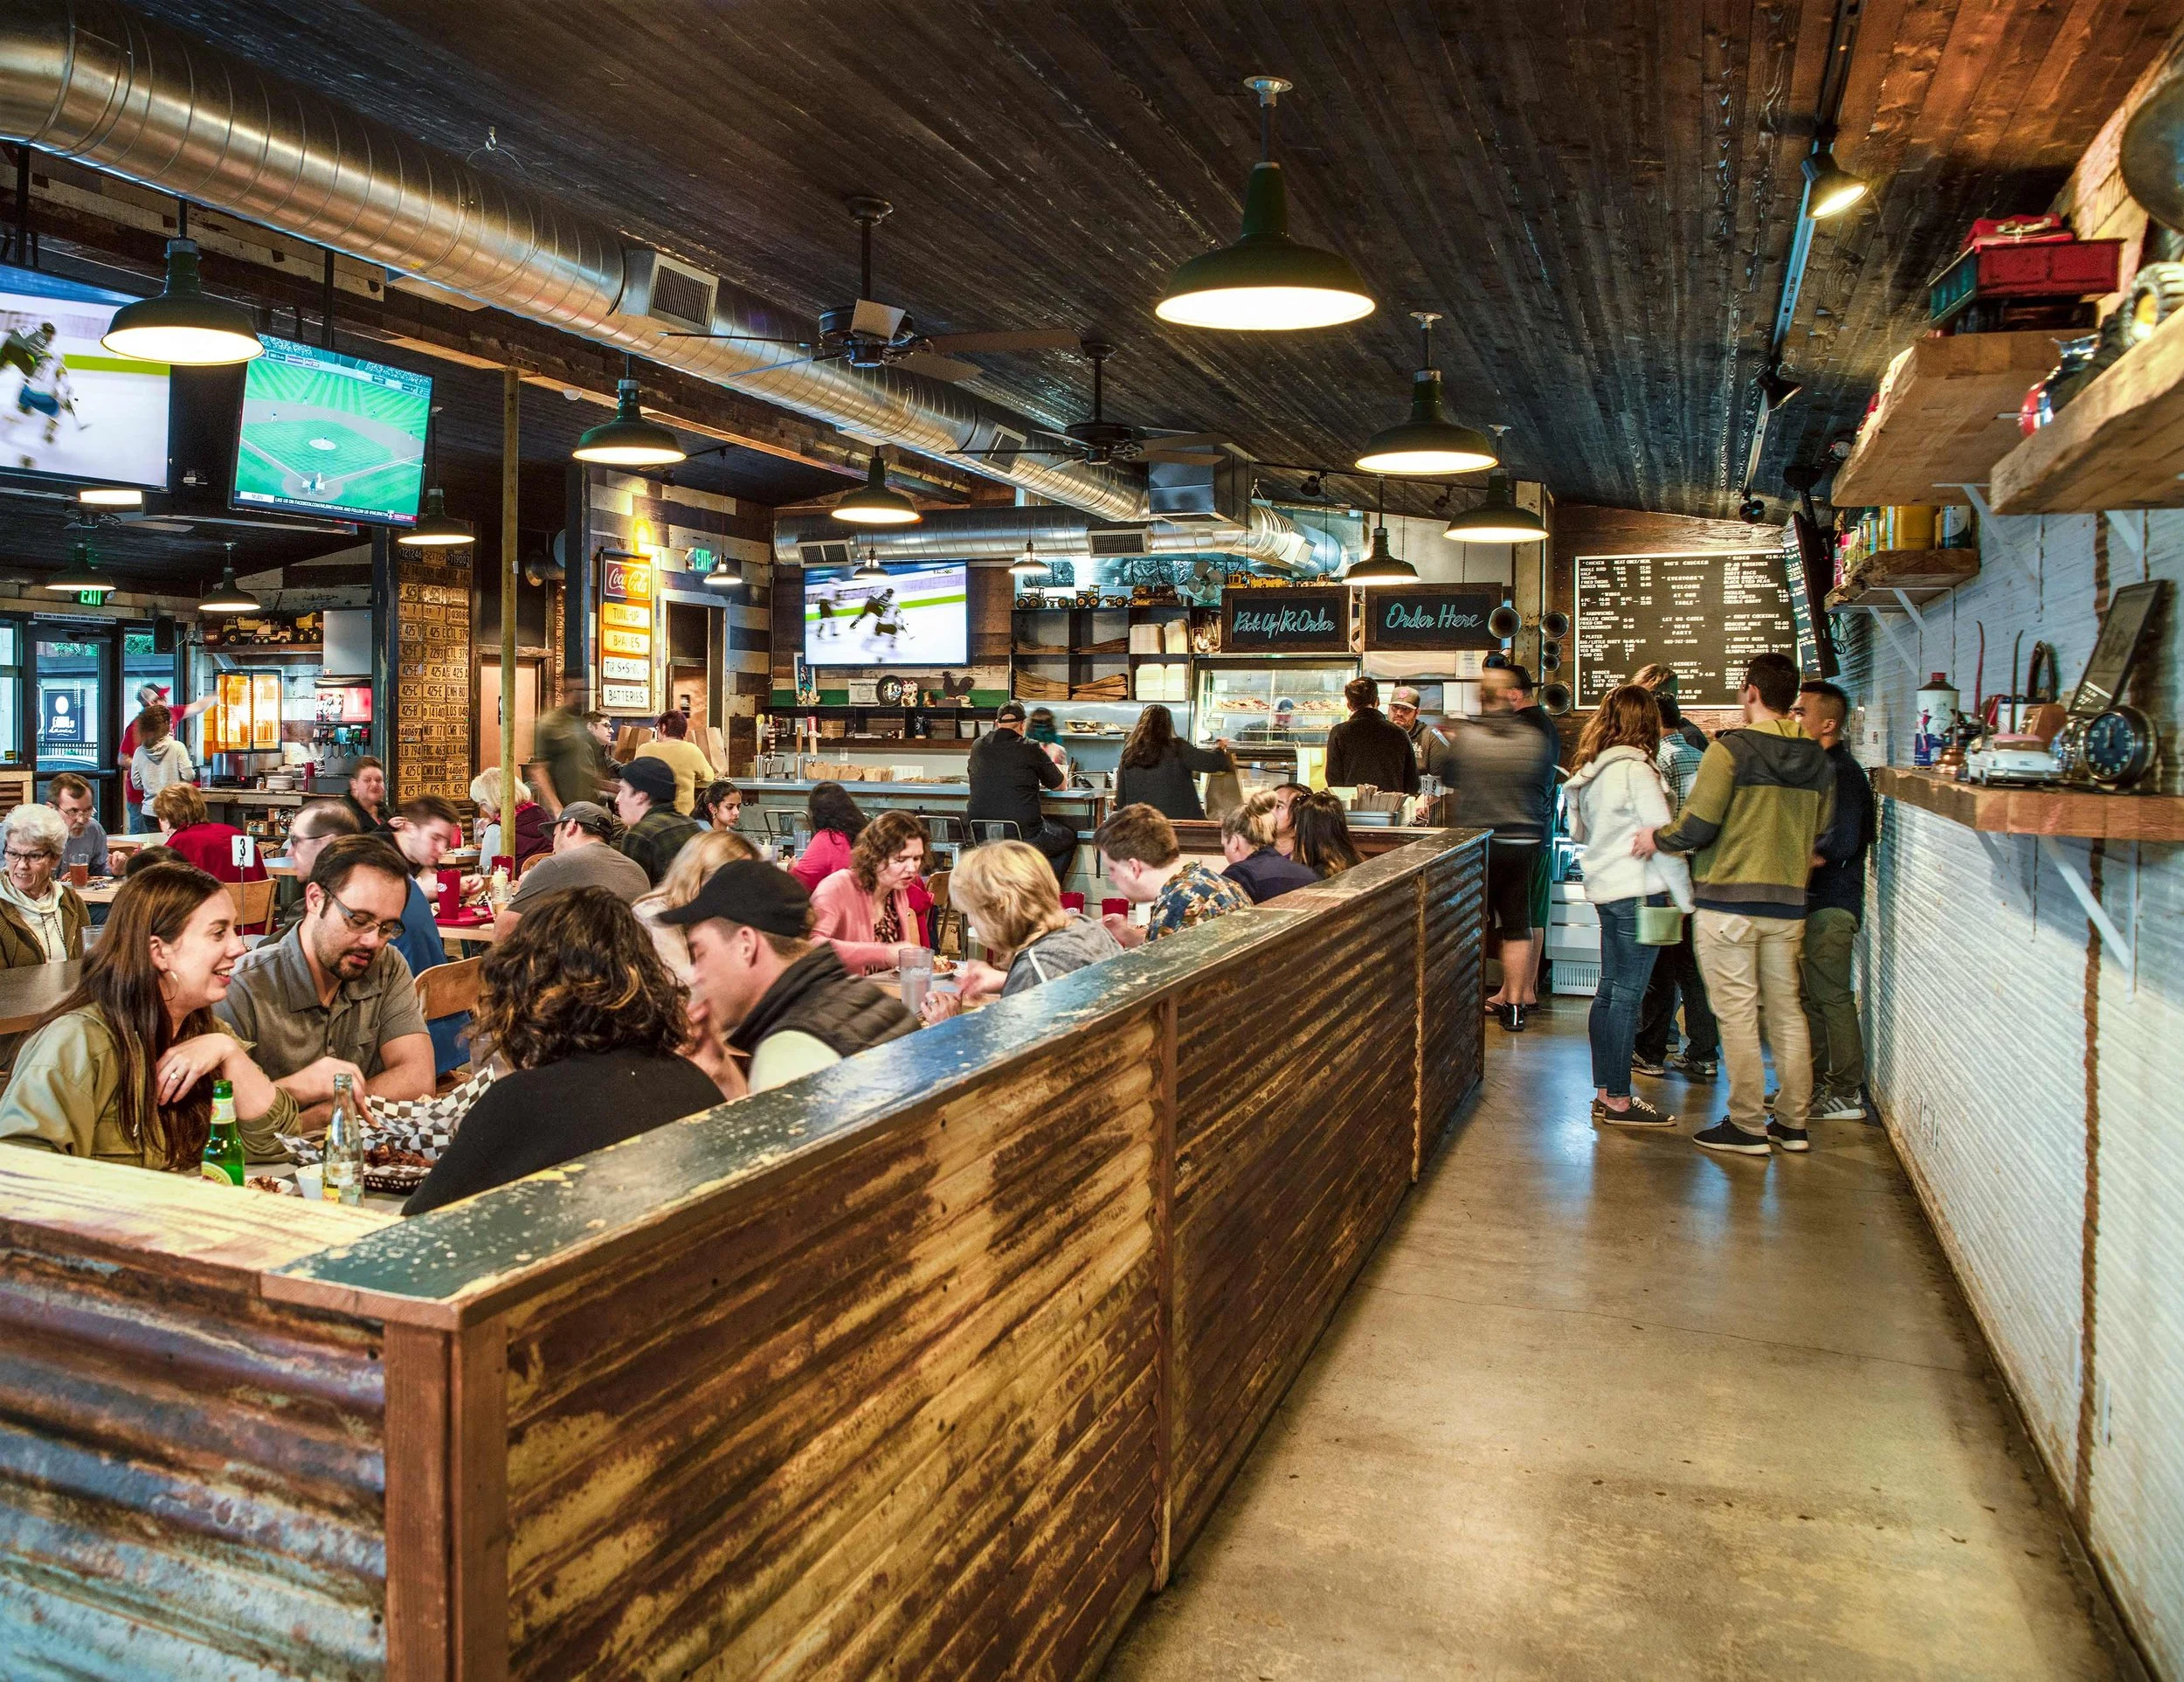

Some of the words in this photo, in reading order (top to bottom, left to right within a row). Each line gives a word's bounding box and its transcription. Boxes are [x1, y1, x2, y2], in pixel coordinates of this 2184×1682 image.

[695, 548, 711, 571] EXIT
[1386, 602, 1435, 629] Order
[1437, 604, 1484, 628] Here
[446, 647, 457, 659] CTL
[459, 648, 469, 659] 379
[431, 666, 442, 677] 425
[442, 667, 446, 678] A
[453, 668, 464, 679] 425
[608, 689, 644, 703] BATTERIES
[405, 765, 417, 777] 425
[453, 783, 464, 794] 425
[464, 784, 468, 794] L
[1432, 779, 1437, 791] 6
[239, 838, 246, 856] 3
